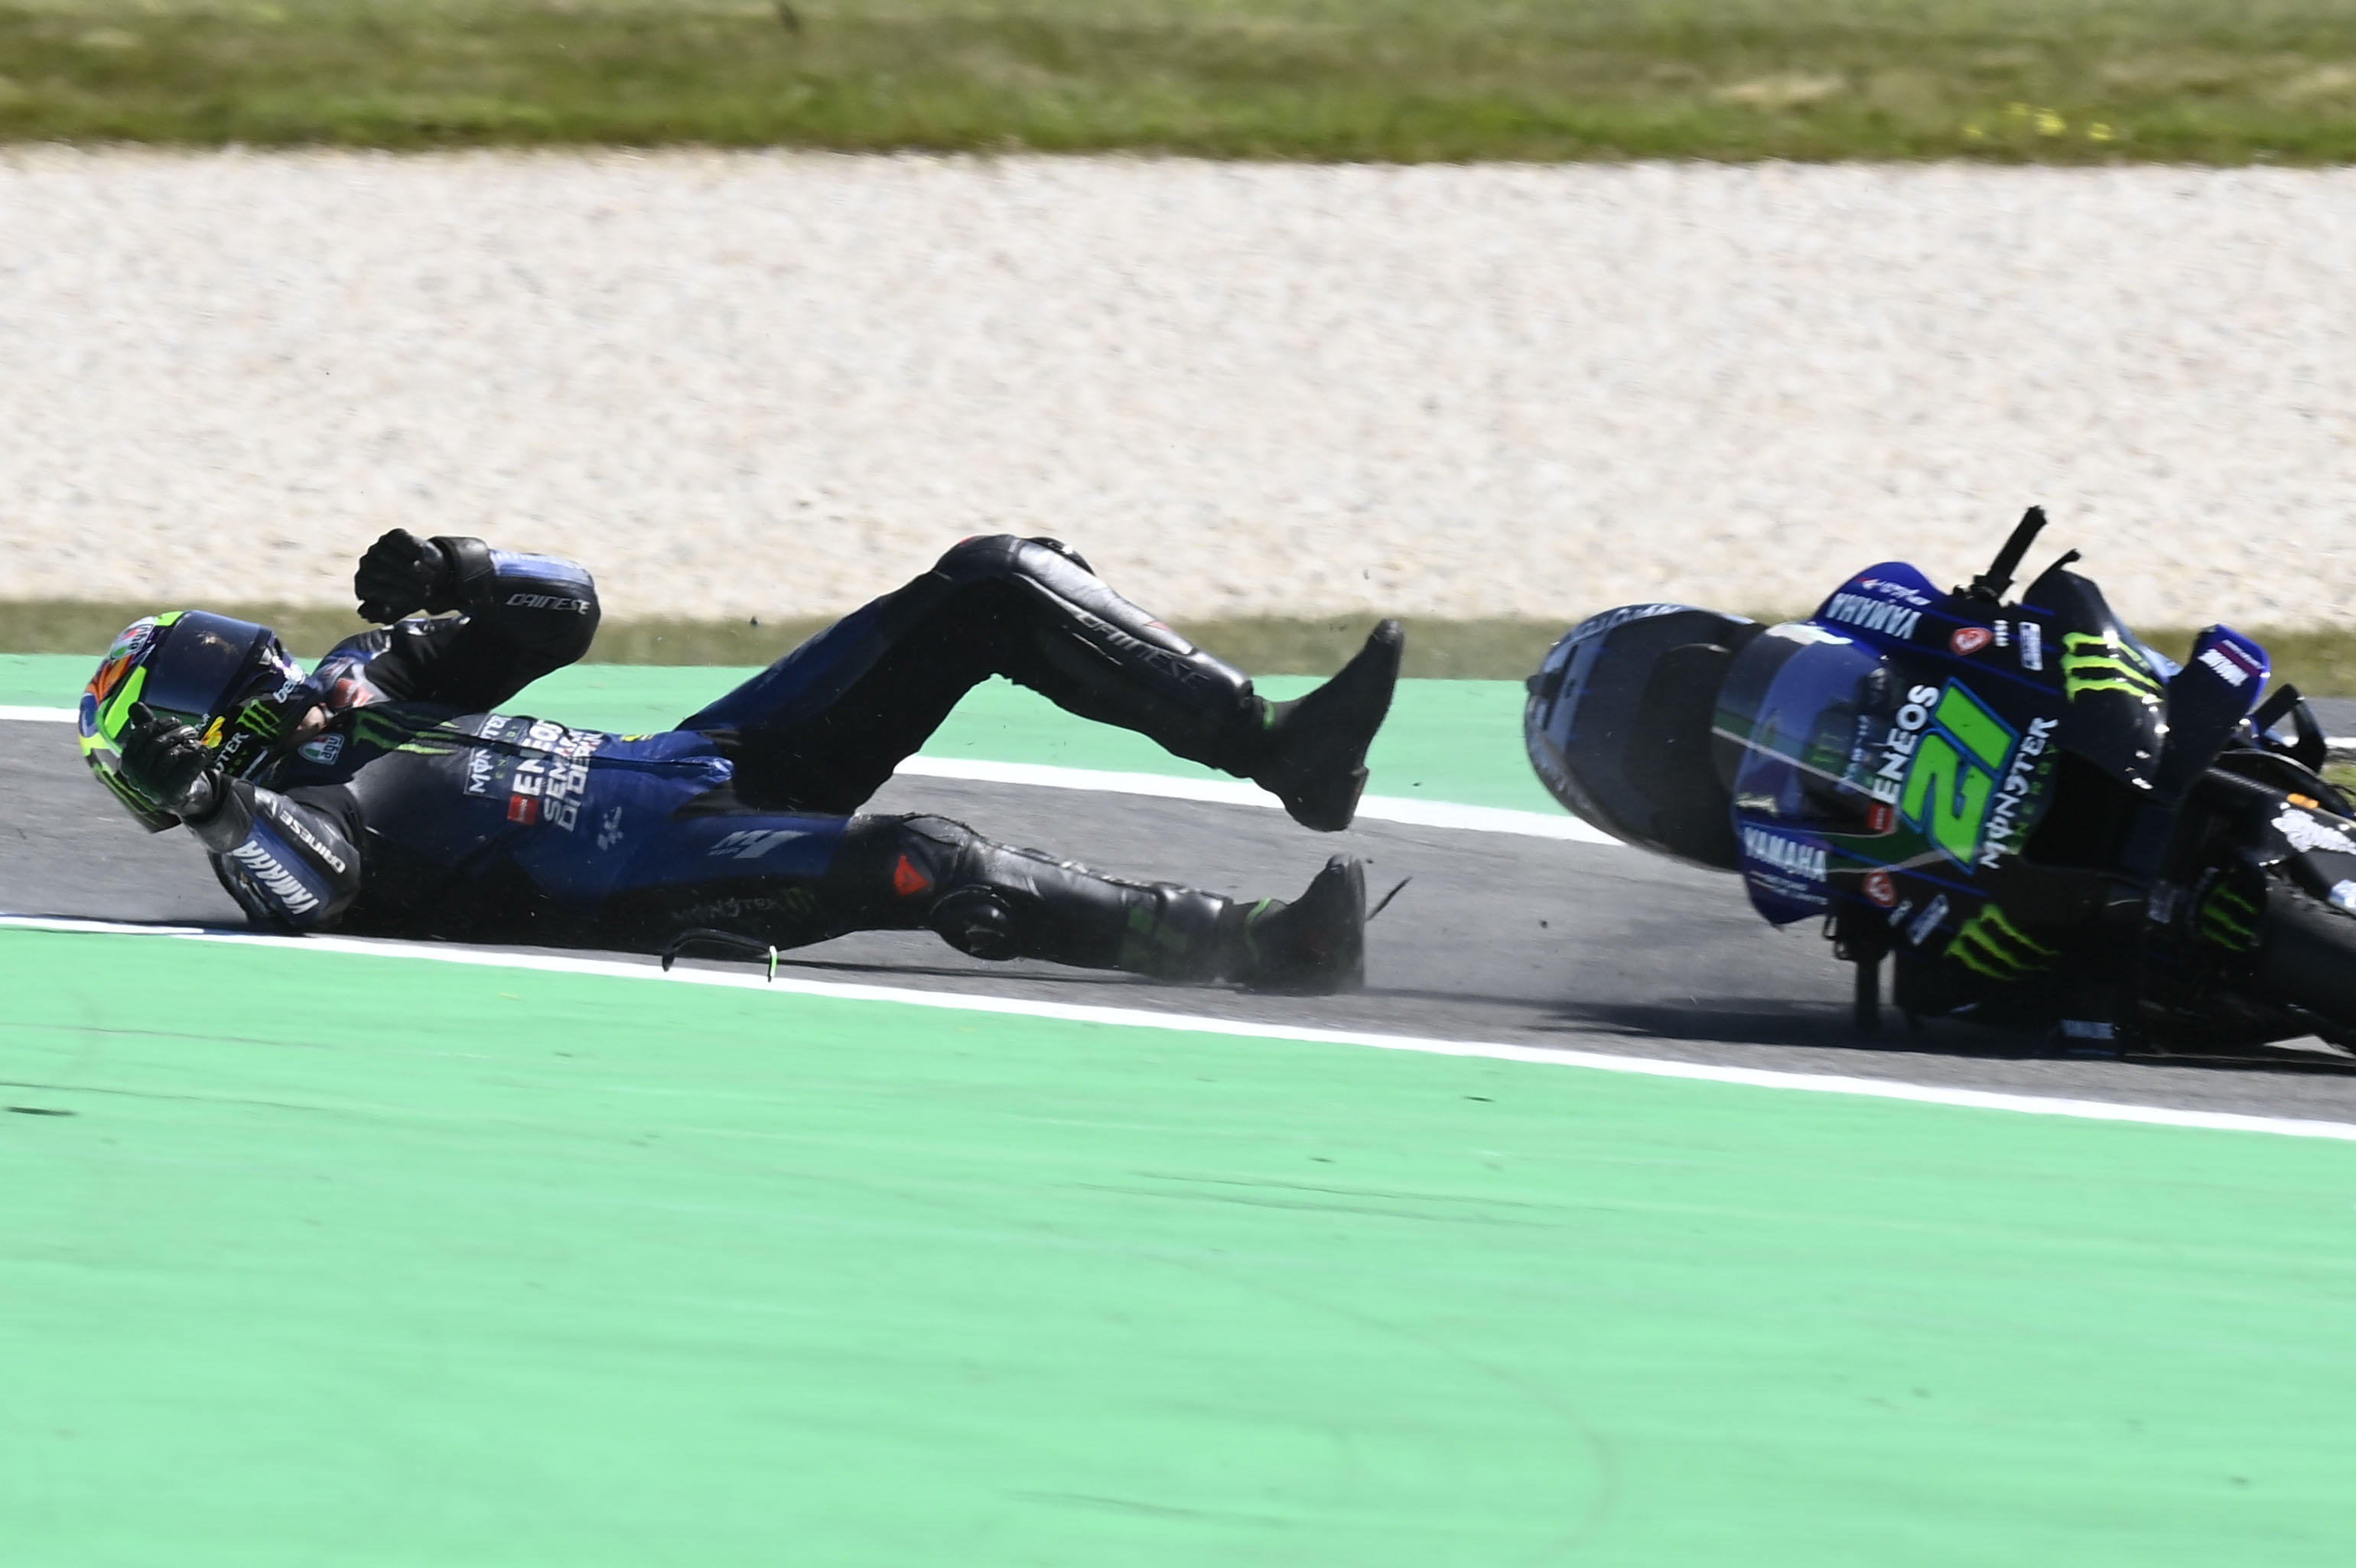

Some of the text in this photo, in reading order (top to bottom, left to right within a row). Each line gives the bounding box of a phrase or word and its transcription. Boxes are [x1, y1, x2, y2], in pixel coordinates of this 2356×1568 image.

[506, 594, 591, 615] DAINESE
[1825, 592, 1922, 639] YAMAHA
[468, 714, 512, 793] MONTER
[1873, 685, 1939, 804] ENEOS
[1899, 678, 2019, 873] 21
[1980, 717, 2058, 870] MONSTER
[232, 840, 319, 914] YAMAHA
[280, 810, 346, 873] DAINESE
[1744, 827, 1827, 883] YAMAHA
